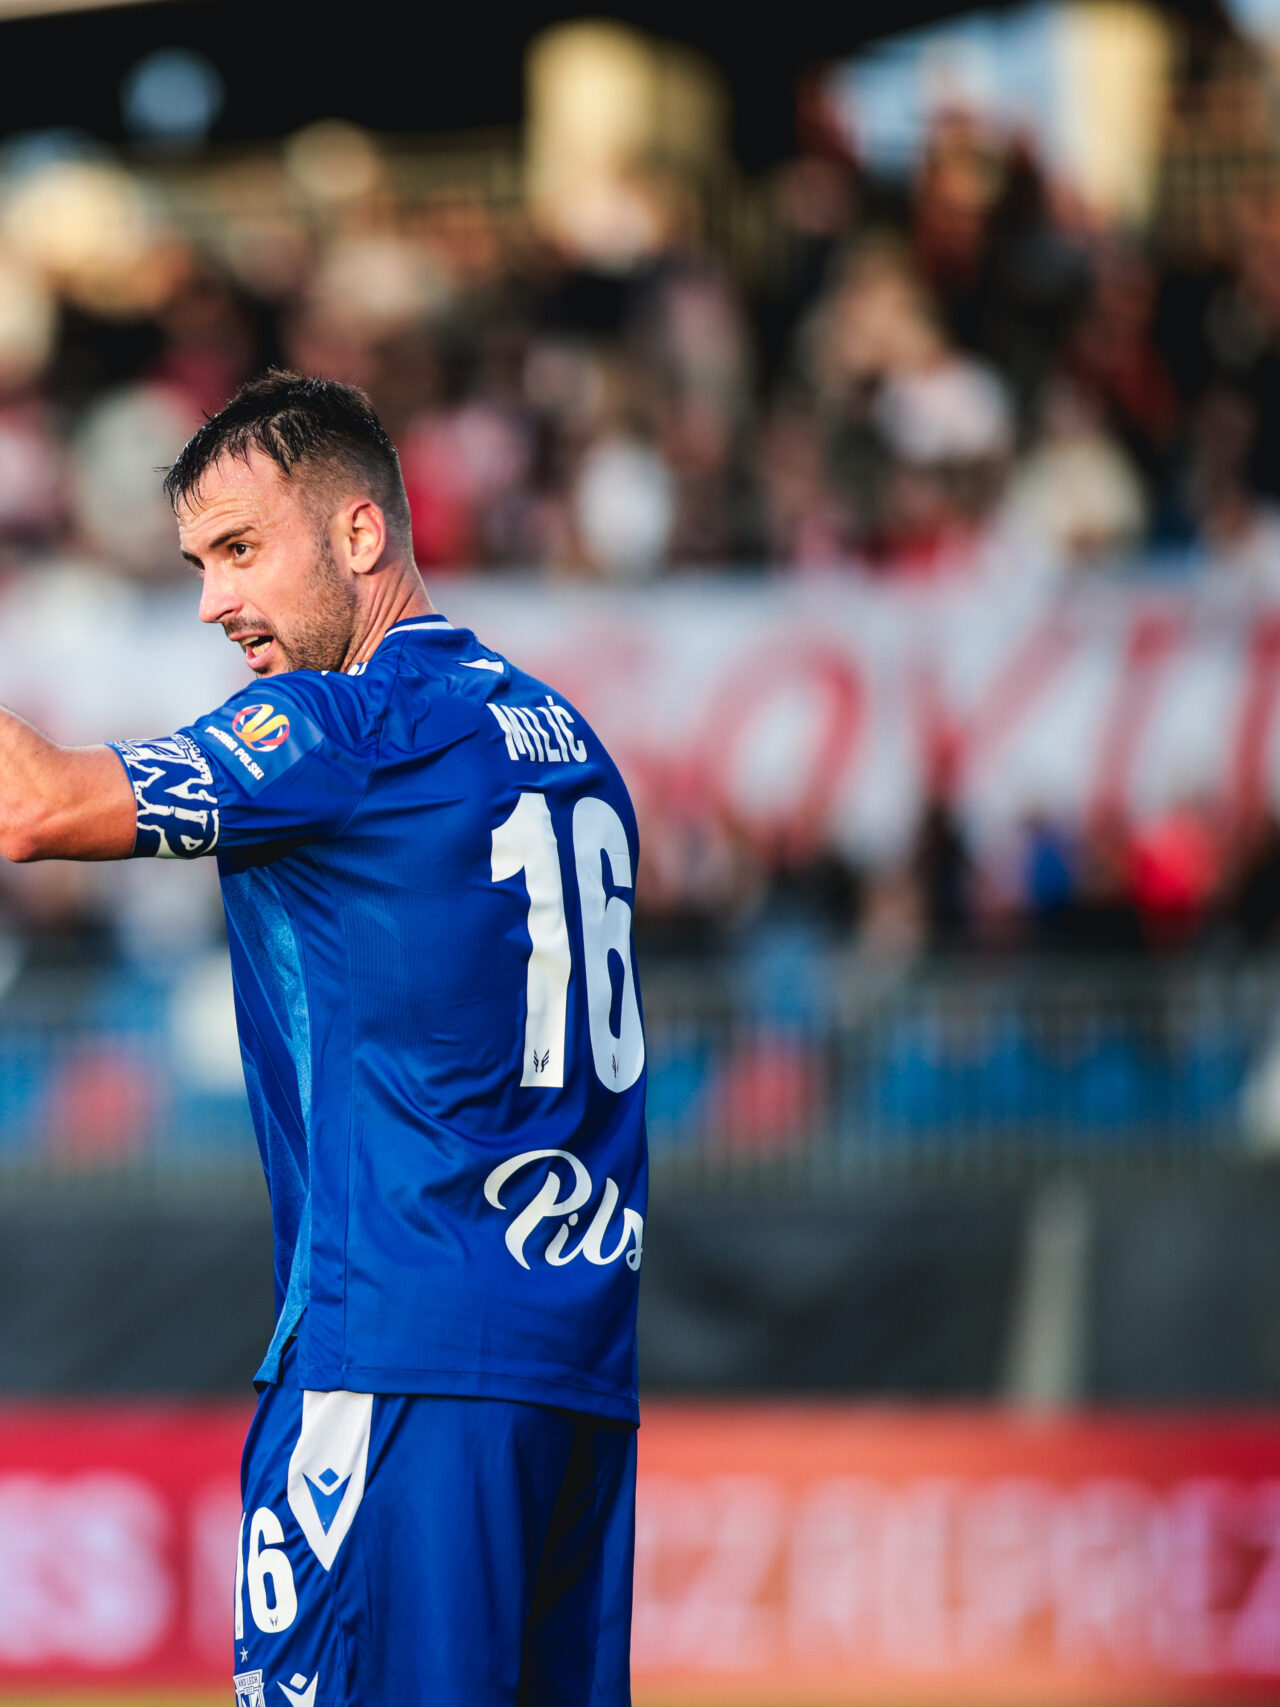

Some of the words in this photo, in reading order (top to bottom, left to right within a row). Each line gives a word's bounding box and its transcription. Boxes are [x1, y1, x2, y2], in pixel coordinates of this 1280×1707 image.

[486, 695, 587, 762] MILIĆ
[234, 747, 264, 780] POLSKI
[492, 793, 645, 1094] 16
